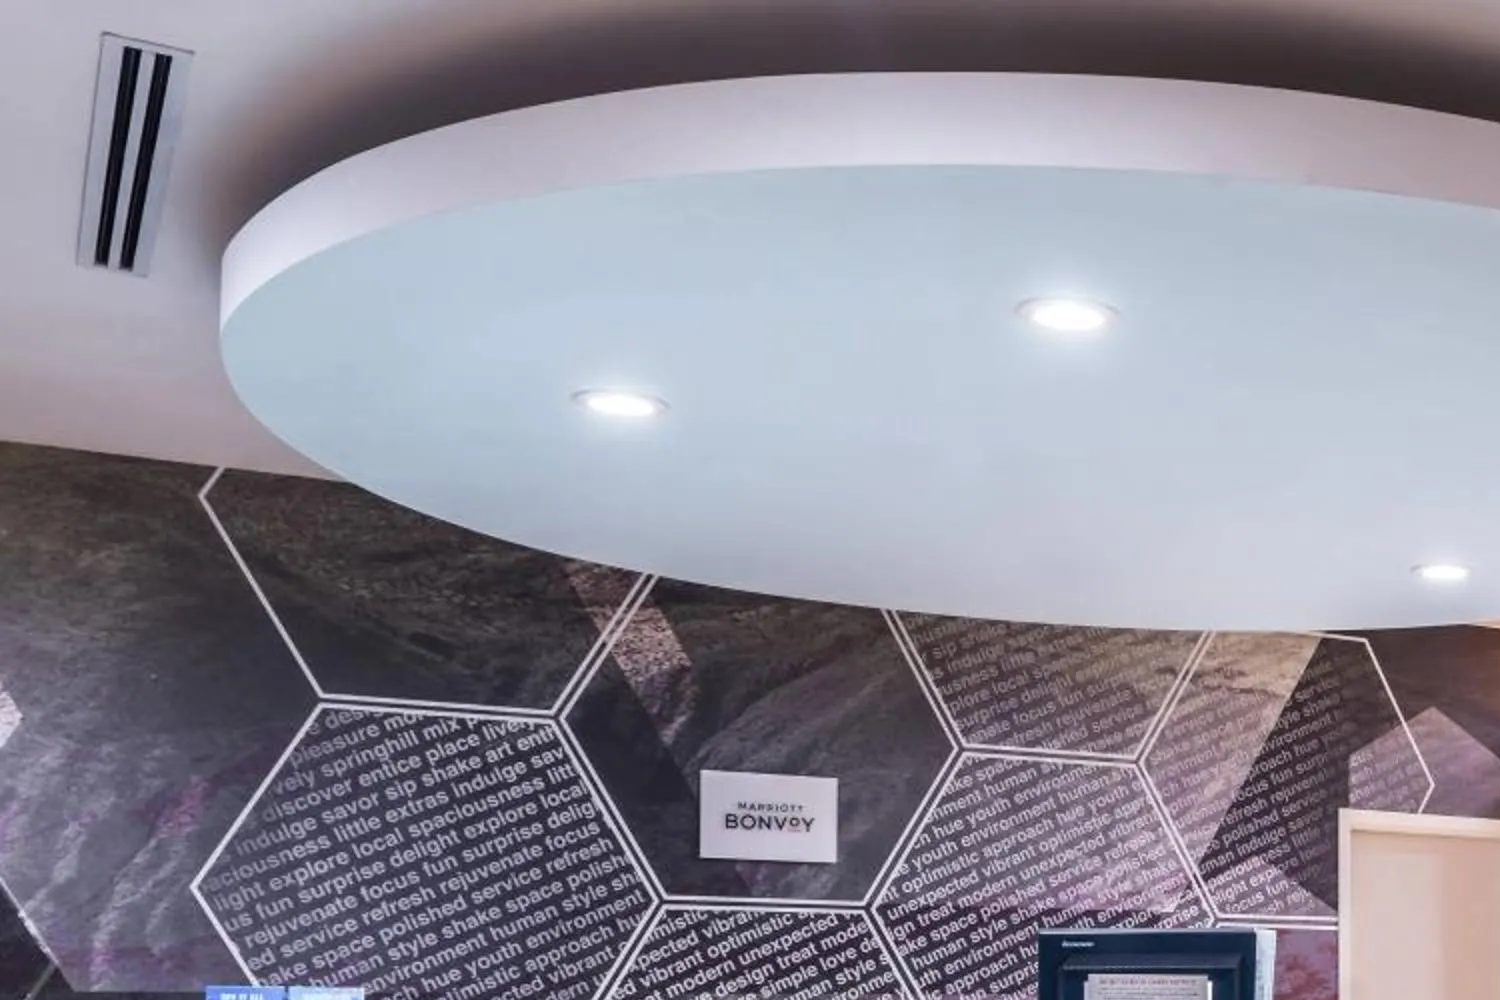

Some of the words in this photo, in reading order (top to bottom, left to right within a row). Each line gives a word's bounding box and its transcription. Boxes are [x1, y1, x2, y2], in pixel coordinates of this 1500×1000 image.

[933, 642, 956, 658] sip
[265, 774, 352, 821] discover
[359, 756, 421, 786] entice
[426, 727, 480, 766] place
[287, 725, 380, 768] pleasure
[321, 730, 419, 777] springhill
[423, 712, 460, 740] mix
[984, 768, 1037, 797] human
[237, 817, 317, 854] indulge
[322, 793, 378, 823] savor
[385, 780, 417, 800] sip
[422, 756, 482, 786] shake
[486, 742, 513, 762] art
[270, 852, 349, 890] explore
[352, 828, 404, 858] local
[409, 778, 544, 837] spaciousness
[333, 817, 381, 842] little
[386, 792, 449, 822] extras
[451, 762, 526, 797] indulge
[725, 813, 816, 833] BONVOY
[738, 801, 804, 813] MARRIOTT
[912, 841, 958, 872] youth
[961, 797, 1056, 847] environment
[1058, 776, 1110, 804] human
[932, 819, 964, 838] hue
[966, 799, 1011, 828] youth
[256, 898, 293, 919] fun
[298, 862, 385, 903] surprise
[390, 830, 461, 867] delight
[464, 802, 537, 838] explore
[540, 776, 586, 808] local
[888, 870, 979, 920] unexpected
[982, 845, 1036, 877] vibrant
[1039, 813, 1111, 852] optimistic
[902, 852, 979, 893] optimistic
[982, 819, 1054, 857] approach
[1056, 806, 1084, 825] hue
[1088, 786, 1129, 814] youth
[917, 901, 955, 926] treat
[957, 876, 1017, 908] modern
[1020, 833, 1105, 880] unexpected
[245, 891, 357, 947] rejuvenate
[360, 871, 420, 901] focus
[423, 856, 458, 876] fun
[462, 823, 543, 862] surprise
[281, 919, 358, 957] service
[362, 887, 436, 925] refresh
[439, 845, 543, 894] rejuvenate
[545, 823, 600, 851] focus
[312, 936, 375, 968] space
[379, 895, 467, 945] polished
[471, 868, 542, 904] service
[546, 838, 613, 874] refresh
[388, 933, 438, 968] style
[442, 907, 501, 938] shake
[506, 882, 563, 912] space
[930, 913, 977, 941] space
[980, 879, 1046, 921] polished
[1049, 856, 1102, 887] service
[362, 933, 488, 993] environment
[490, 906, 558, 940] human
[562, 885, 607, 911] style
[421, 969, 461, 992] hue
[465, 943, 523, 978] youth
[526, 890, 644, 948] environment
[525, 926, 614, 972] approach
[548, 946, 614, 983] vibrant
[640, 951, 704, 987] vibrant
[707, 909, 792, 958] optimistic
[666, 960, 735, 998] modern
[739, 912, 838, 971] unexpected
[716, 964, 774, 997] design
[777, 943, 818, 969] treat
[836, 960, 876, 984] style
[911, 938, 967, 969] human
[970, 919, 1007, 943] style
[1011, 897, 1056, 924] shake
[942, 922, 1044, 974] environment
[761, 966, 818, 1000] simple
[819, 948, 857, 970] love
[946, 953, 1018, 995] approach
